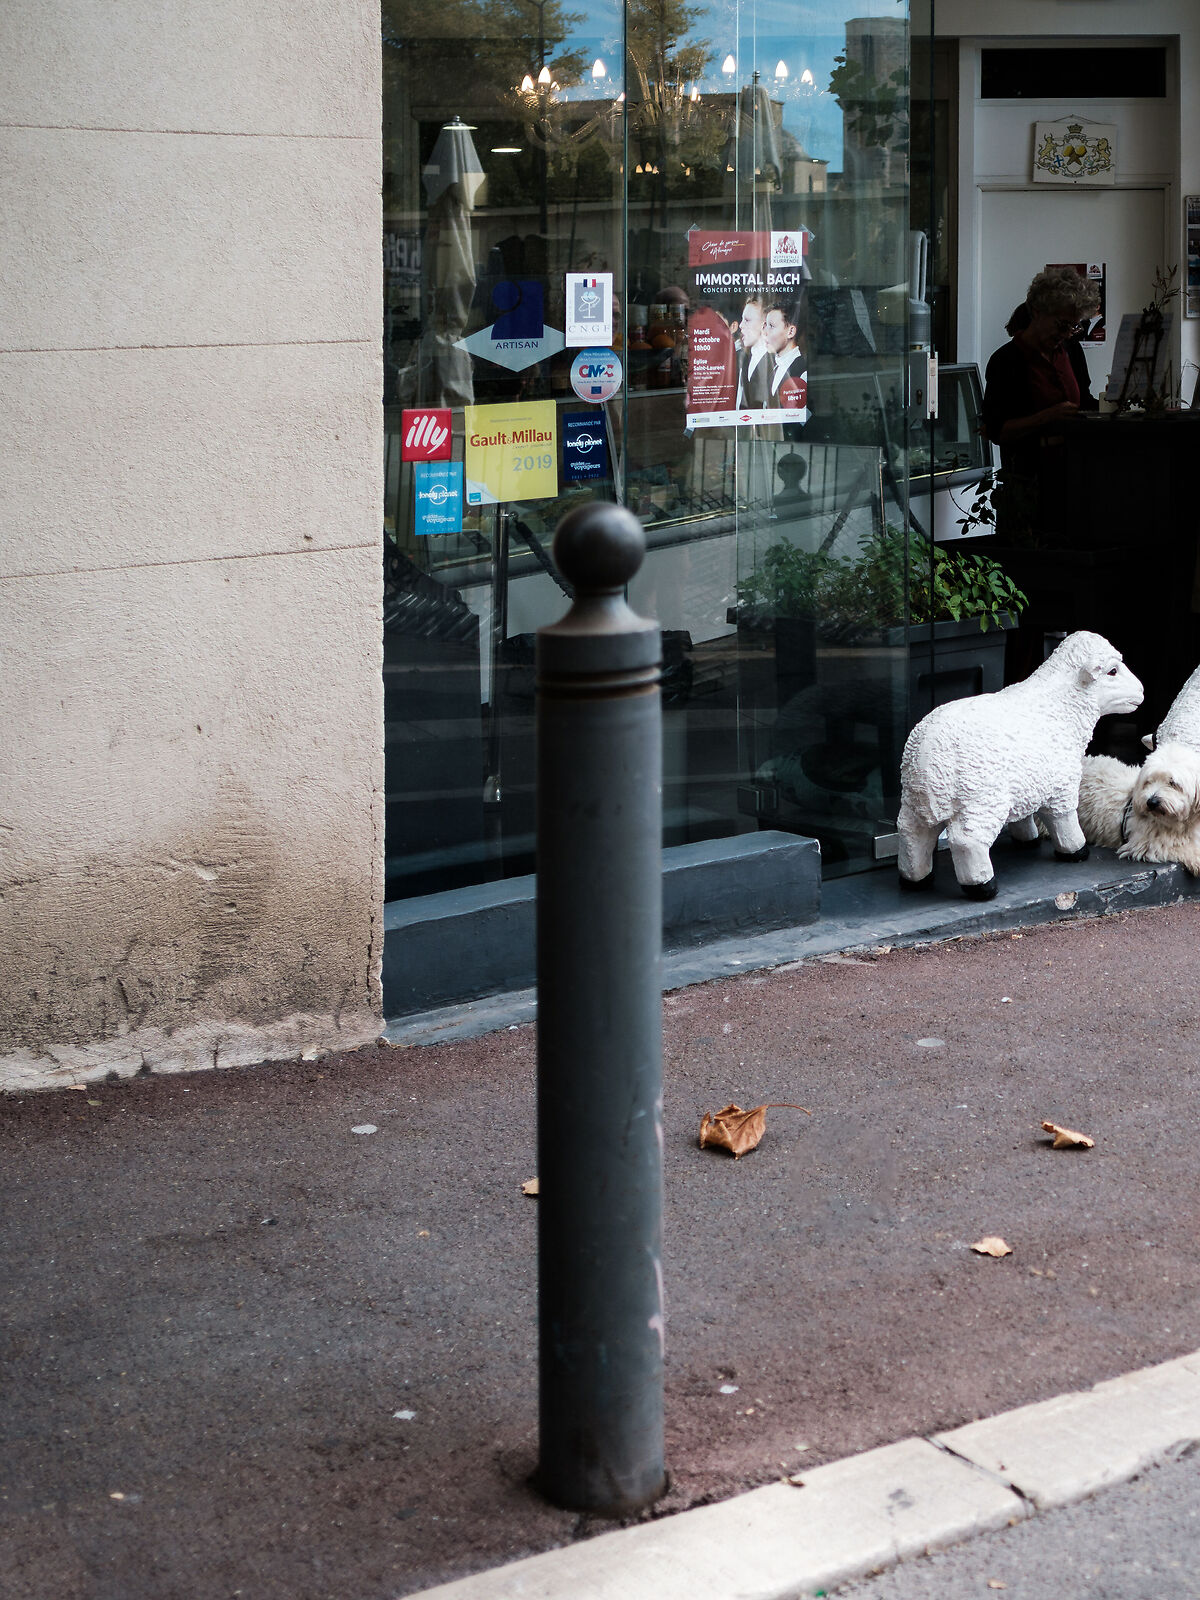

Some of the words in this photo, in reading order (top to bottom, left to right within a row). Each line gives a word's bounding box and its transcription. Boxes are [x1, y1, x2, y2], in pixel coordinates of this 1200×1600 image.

[695, 273, 764, 286] IMMORTAL
[766, 273, 800, 285] BACH
[495, 341, 539, 350] ARTISAN
[405, 415, 448, 454] illy
[566, 439, 584, 449] lonely
[584, 438, 602, 448] planet
[512, 454, 553, 472] 2019
[419, 491, 438, 500] lonely
[438, 490, 458, 499] planet
